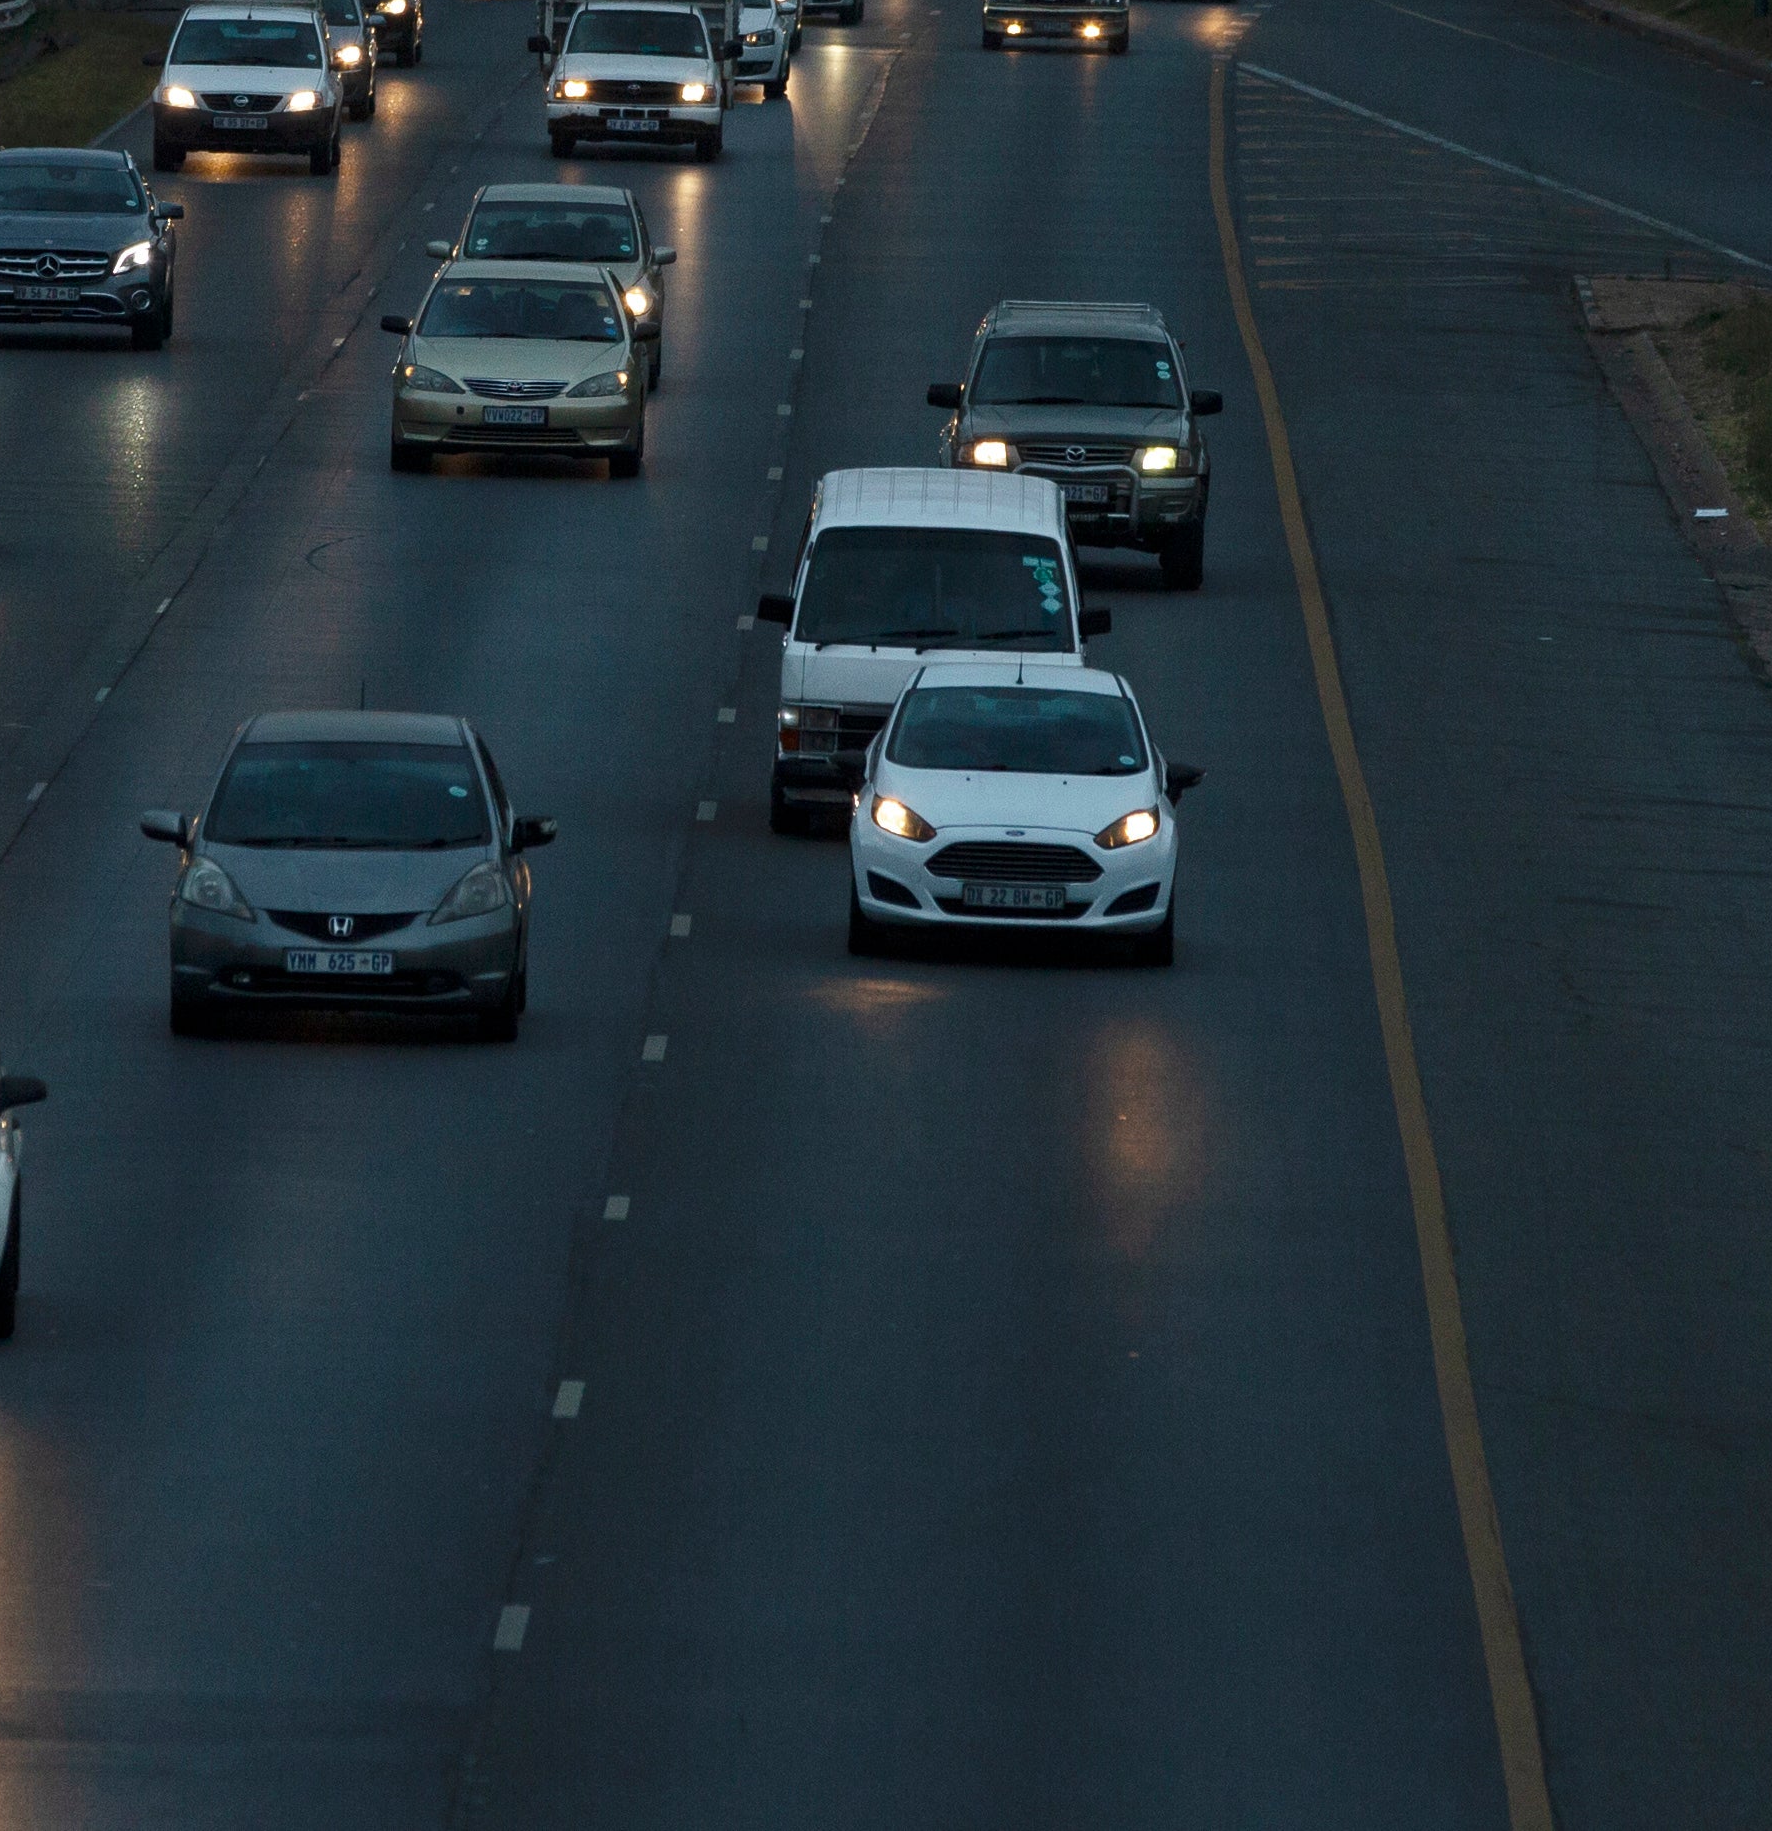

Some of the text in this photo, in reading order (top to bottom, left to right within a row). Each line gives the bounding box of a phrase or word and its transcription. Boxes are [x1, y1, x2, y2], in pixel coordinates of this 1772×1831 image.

[67, 288, 79, 299] GP
[531, 410, 544, 423] GP
[1092, 487, 1106, 501] GP
[967, 888, 1063, 907] DX 22 BW GP
[288, 952, 390, 972] YMM 625 GP
